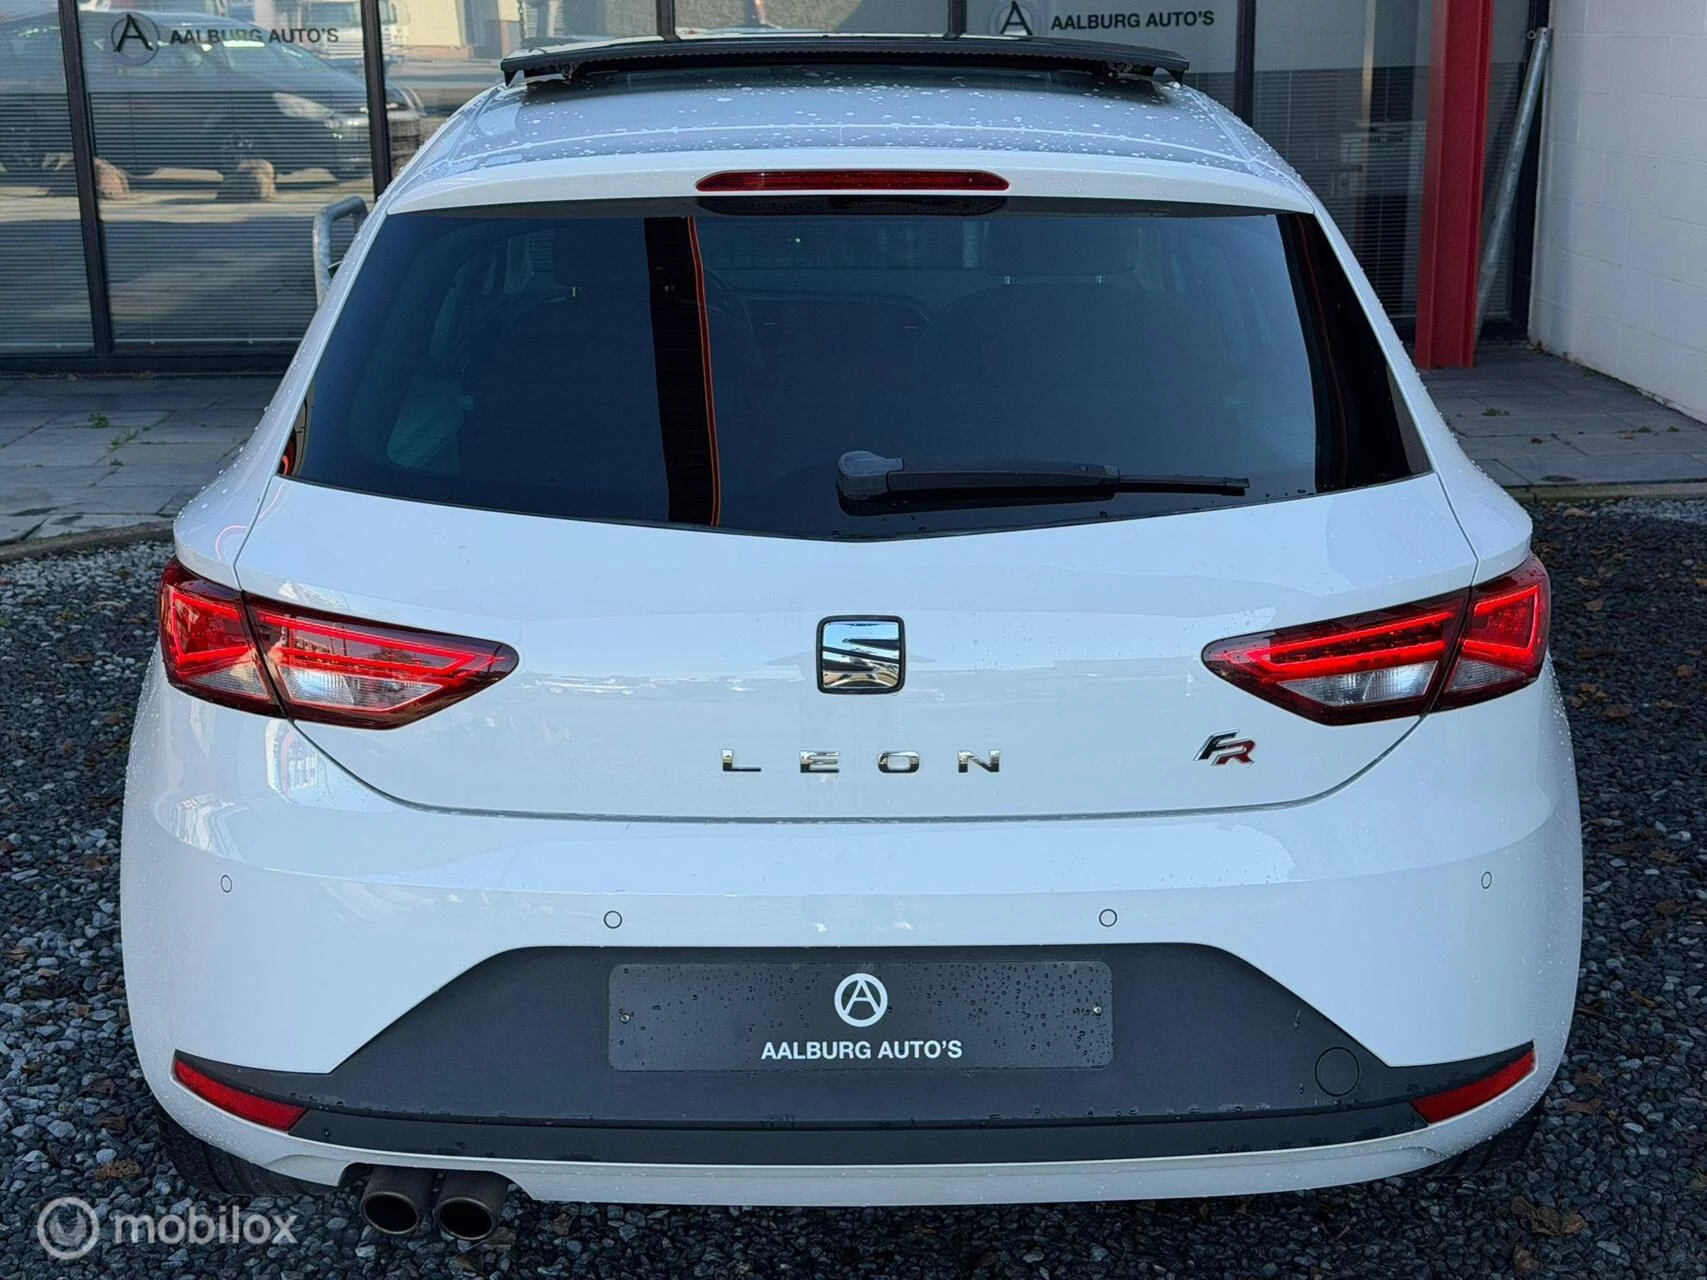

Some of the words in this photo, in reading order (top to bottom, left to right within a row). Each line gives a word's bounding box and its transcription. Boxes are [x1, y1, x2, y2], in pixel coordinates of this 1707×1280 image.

[1051, 13, 1141, 30] AALBURG
[1146, 10, 1214, 27] AUTO'S
[170, 28, 263, 45] AALBURG
[269, 27, 339, 43] AUTO'S
[1195, 730, 1255, 766] FR
[721, 748, 1001, 773] LEON
[761, 1041, 871, 1060] AALBURG
[878, 1040, 963, 1059] AUTO'S
